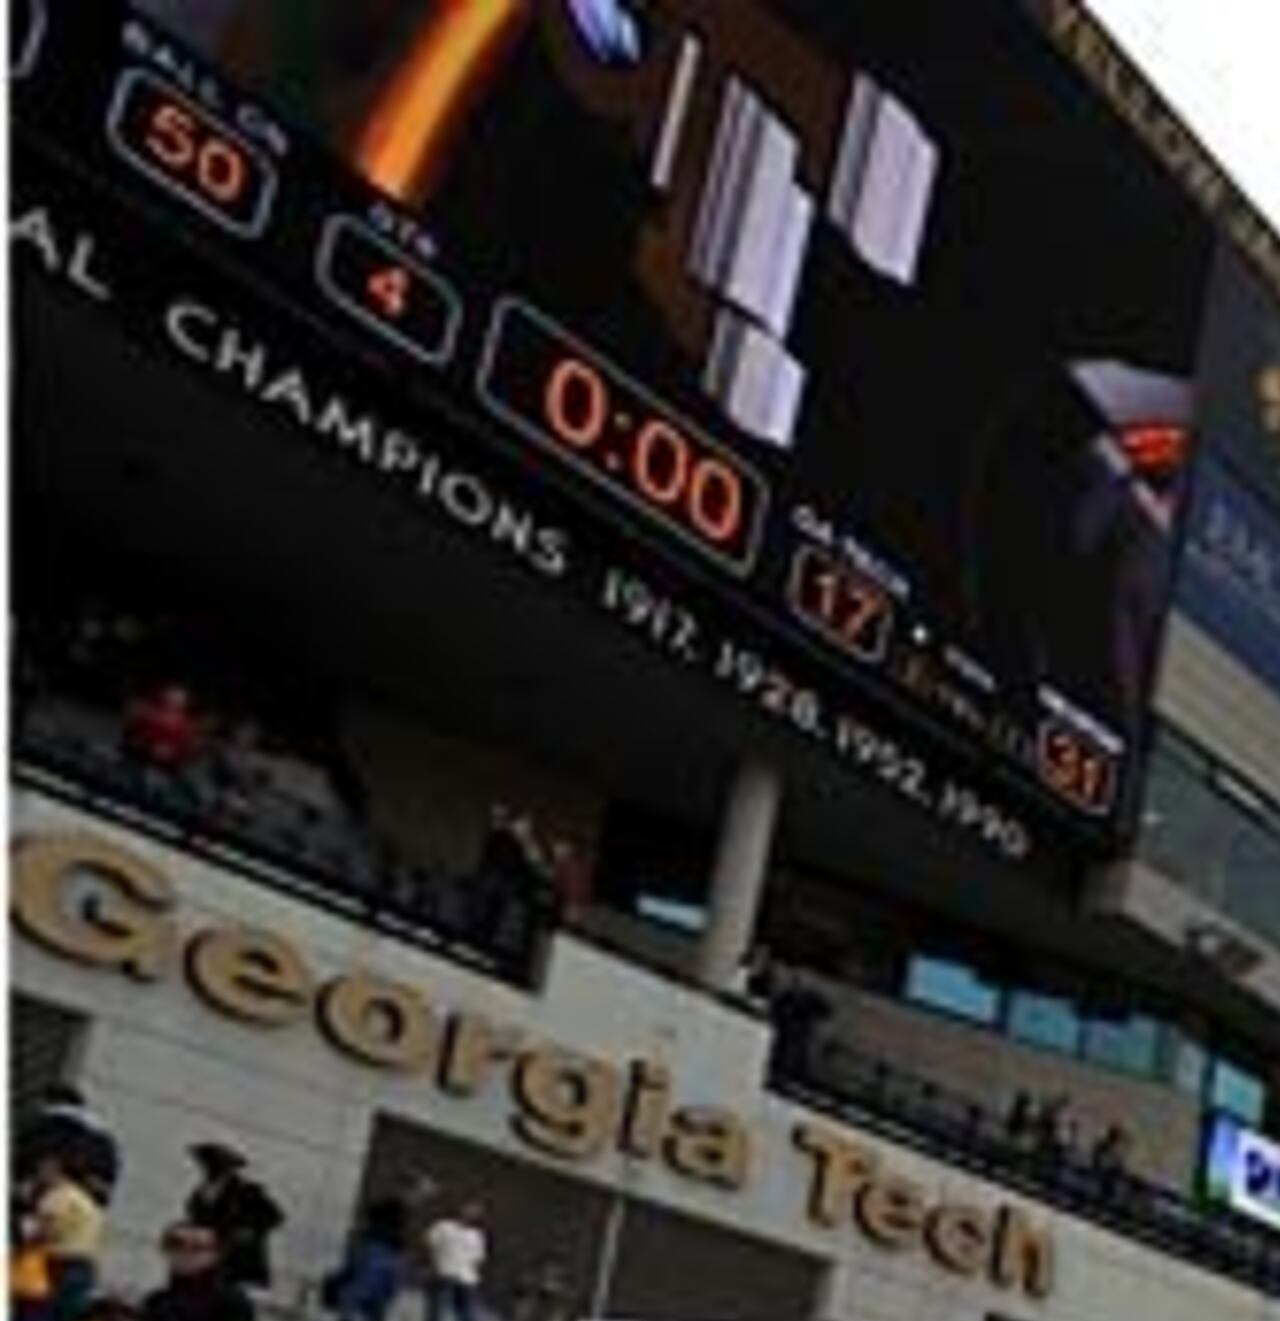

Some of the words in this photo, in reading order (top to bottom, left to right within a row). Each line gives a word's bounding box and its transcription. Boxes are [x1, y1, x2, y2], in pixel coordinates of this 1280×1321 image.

[147, 104, 245, 202] 50
[366, 266, 409, 316] 4
[9, 205, 112, 300] AL
[165, 300, 570, 575] CHAMPIONS
[543, 357, 742, 541] 0:00
[812, 571, 884, 648] 17
[9, 832, 753, 1192] Georgia
[790, 1121, 1056, 1300] Tech
